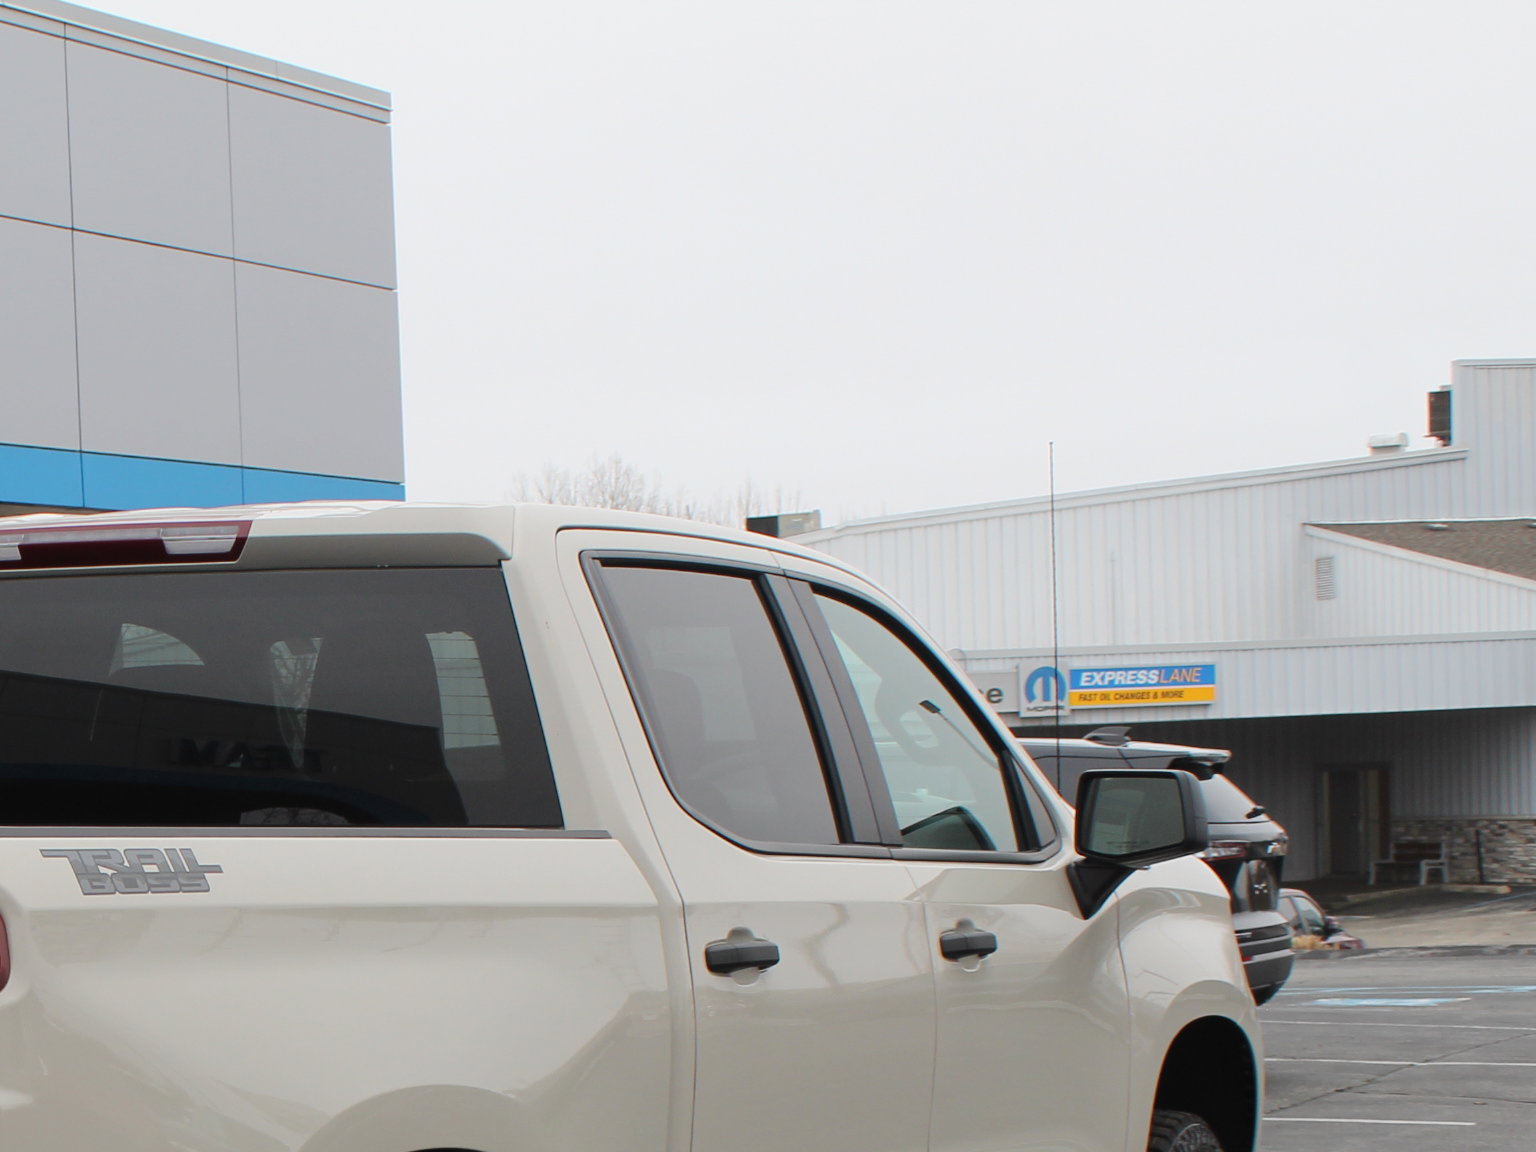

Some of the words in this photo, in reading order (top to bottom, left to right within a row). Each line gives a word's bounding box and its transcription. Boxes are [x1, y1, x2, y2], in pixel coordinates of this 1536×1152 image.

[1078, 693, 1098, 702] FAST
[1100, 692, 1111, 701] OIL
[1114, 691, 1151, 701] CHANGES
[1153, 691, 1159, 699] &
[1161, 690, 1184, 699] MORE
[39, 848, 224, 873] TRAIL
[77, 872, 210, 896] BOSS
